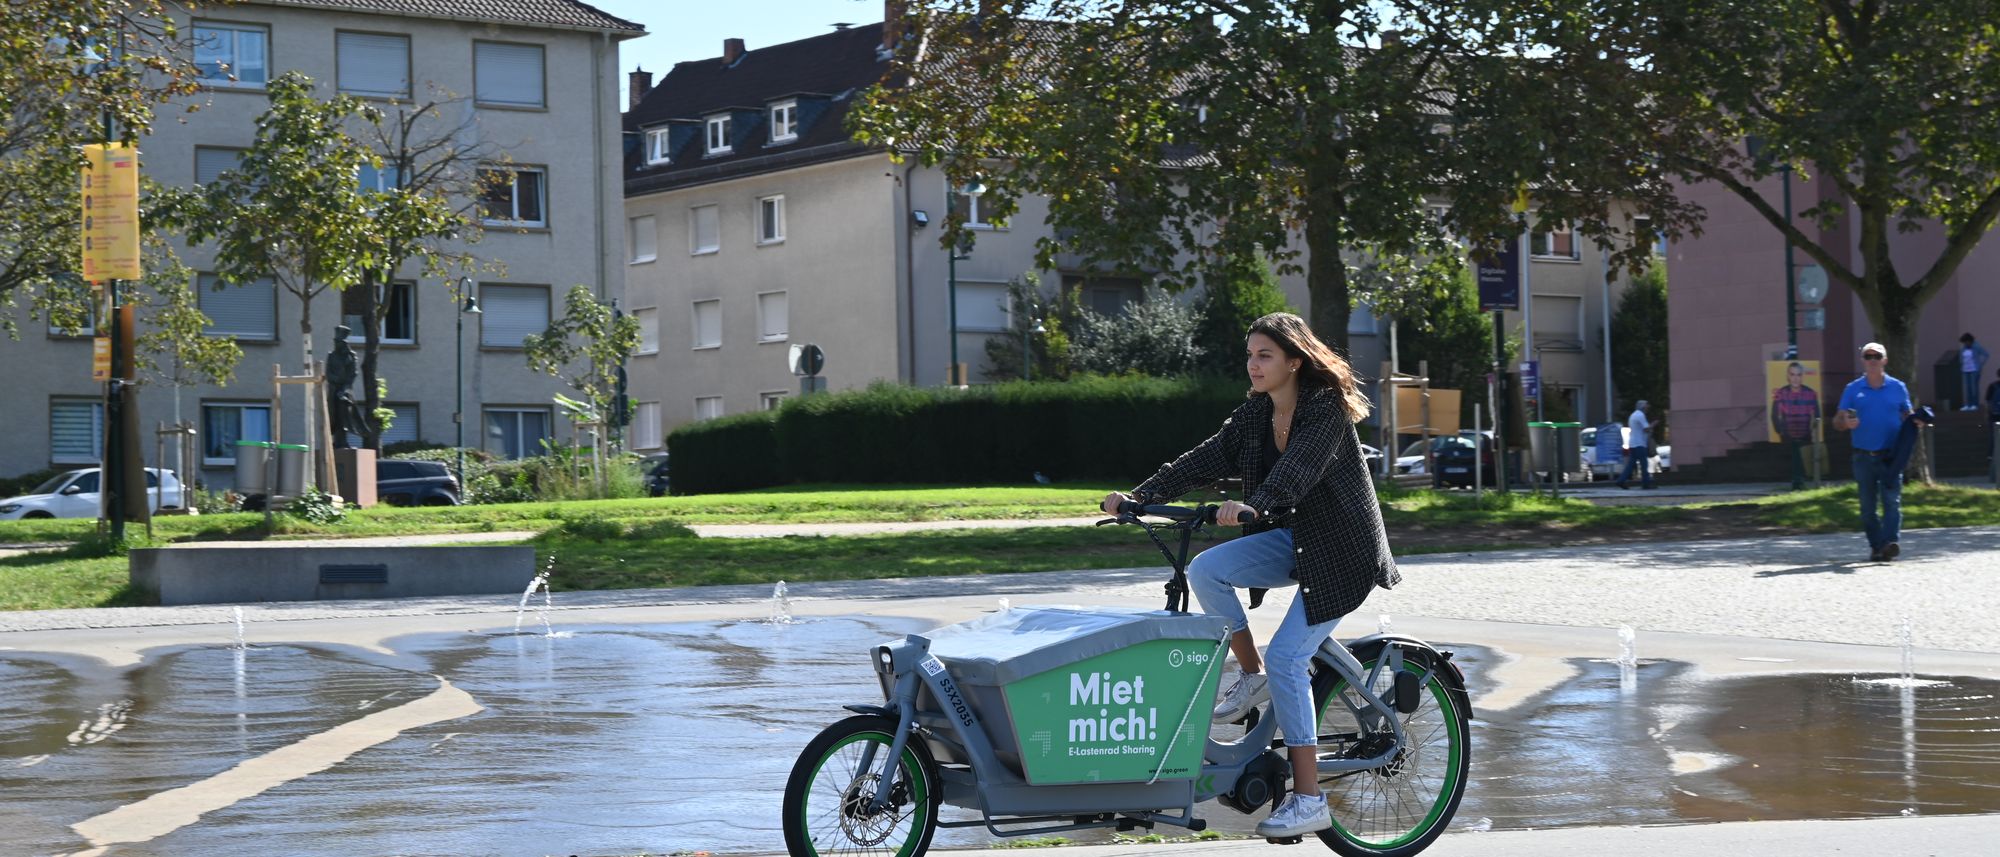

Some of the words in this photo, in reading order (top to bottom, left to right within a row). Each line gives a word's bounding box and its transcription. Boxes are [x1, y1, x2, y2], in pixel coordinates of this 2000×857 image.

[1187, 651, 1209, 665] sigo
[939, 678, 974, 727] S3X2035
[1070, 672, 1144, 706] Miet
[1069, 708, 1157, 742] mich!
[1068, 746, 1120, 756] E-Lastenrad
[1122, 745, 1155, 756] Sharing
